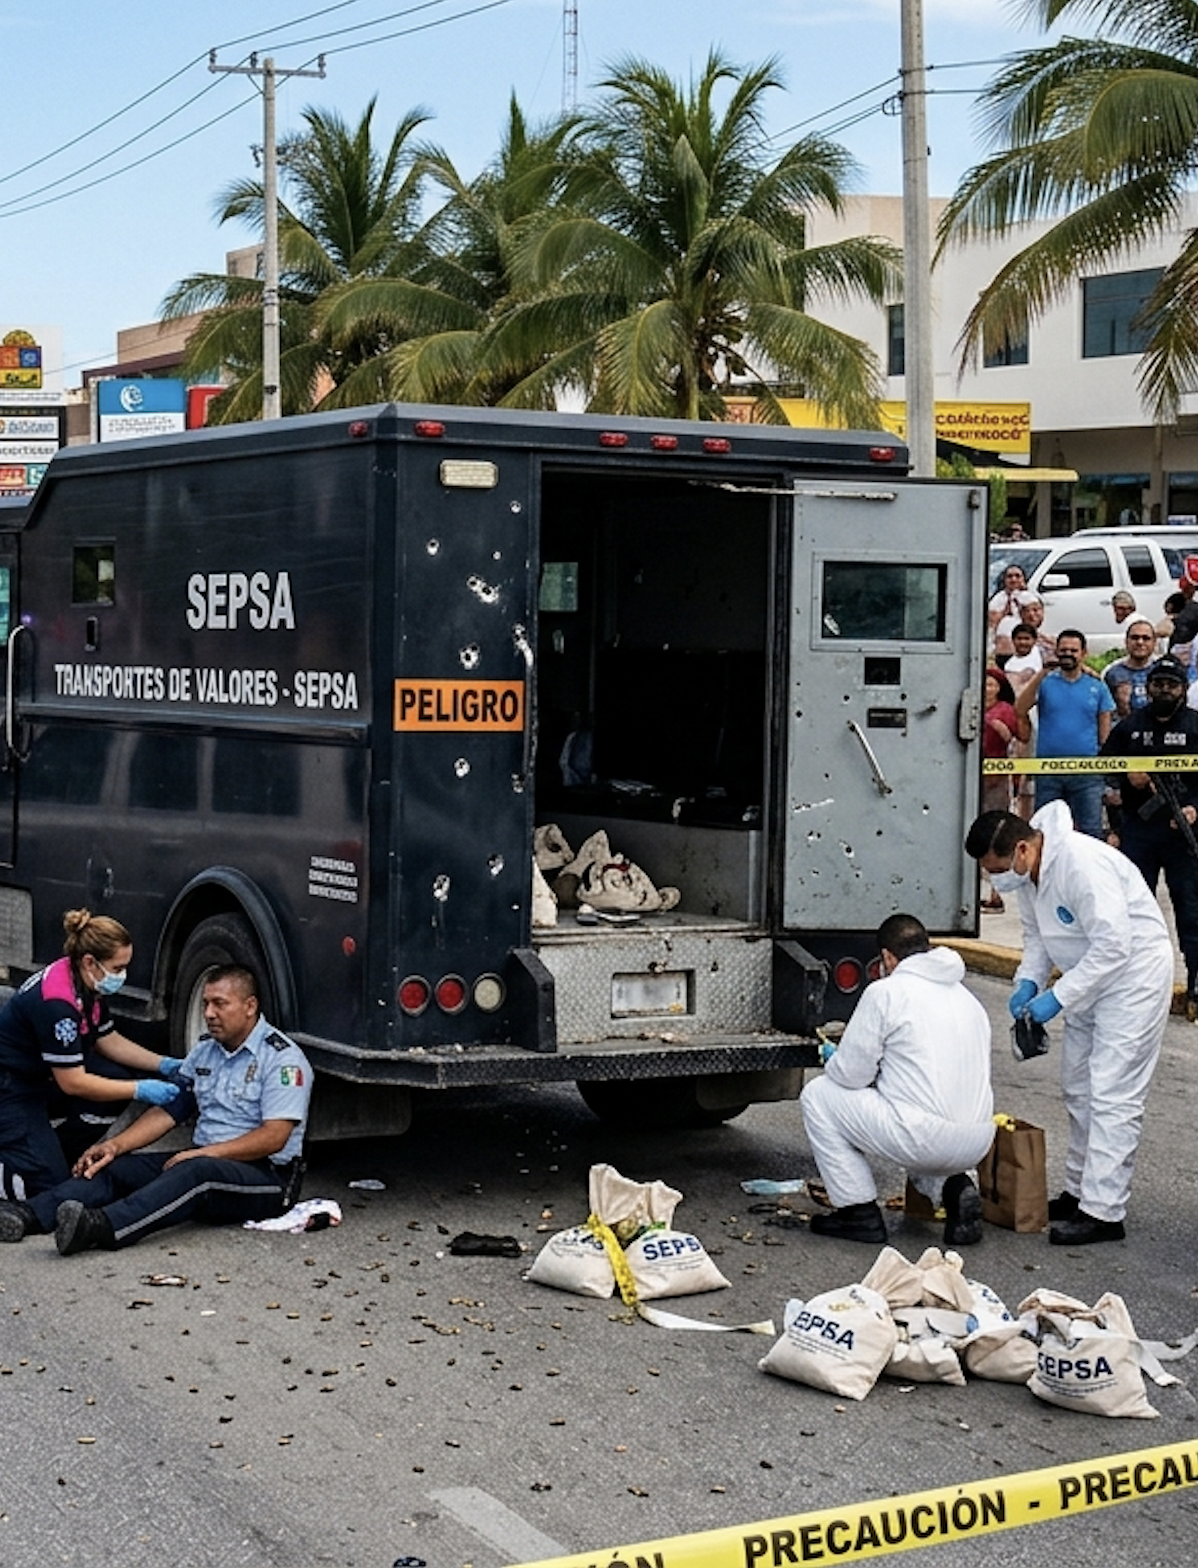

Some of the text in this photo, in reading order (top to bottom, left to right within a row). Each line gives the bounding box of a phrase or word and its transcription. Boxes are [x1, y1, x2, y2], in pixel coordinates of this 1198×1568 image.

[186, 570, 296, 631] SEPSA
[168, 667, 192, 701] DE
[194, 667, 279, 706] VALORES
[293, 670, 358, 710] SEPSA
[400, 688, 519, 722] PELIGRO
[743, 1488, 1006, 1568] PRECAUCIÓN
